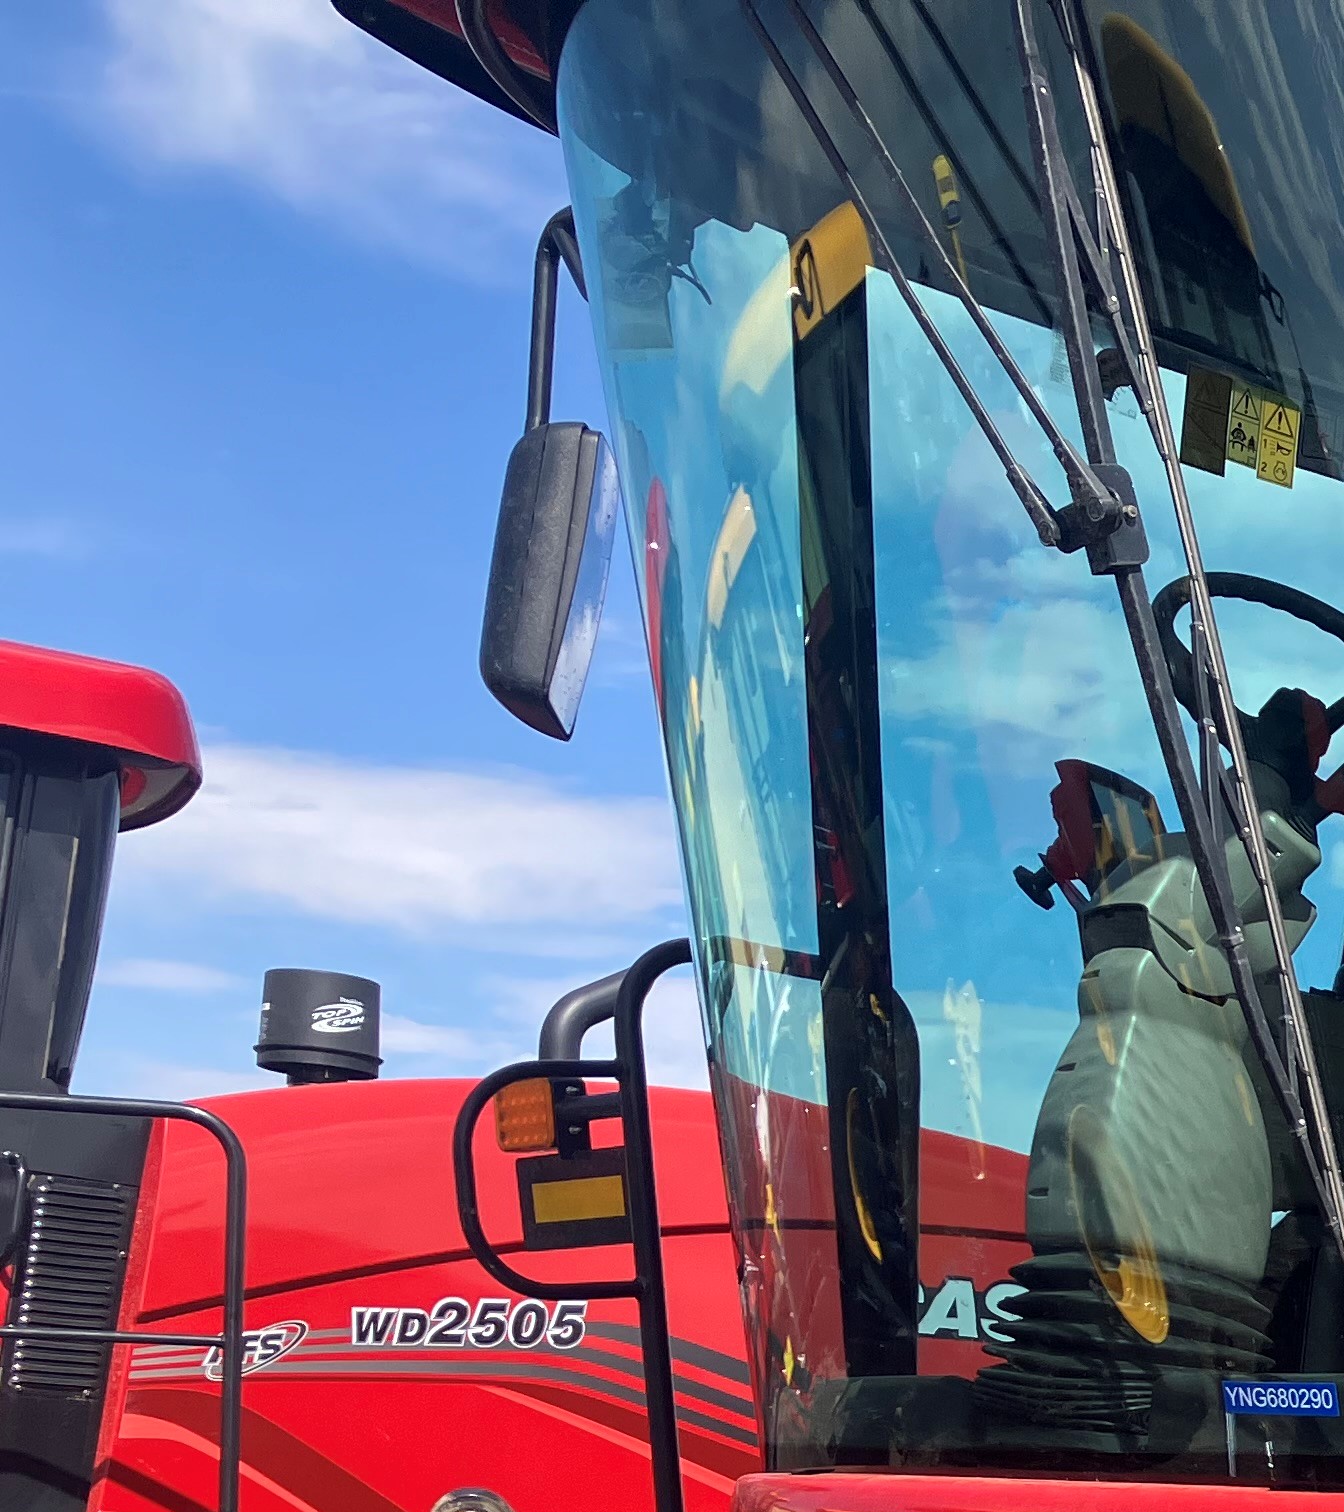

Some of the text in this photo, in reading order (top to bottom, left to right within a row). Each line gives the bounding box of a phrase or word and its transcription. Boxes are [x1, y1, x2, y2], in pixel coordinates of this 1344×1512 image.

[311, 1007, 347, 1020] TOP
[331, 1016, 365, 1027] SPIN
[351, 1296, 589, 1350] WD2505
[1224, 1386, 1333, 1409] YNG680290
